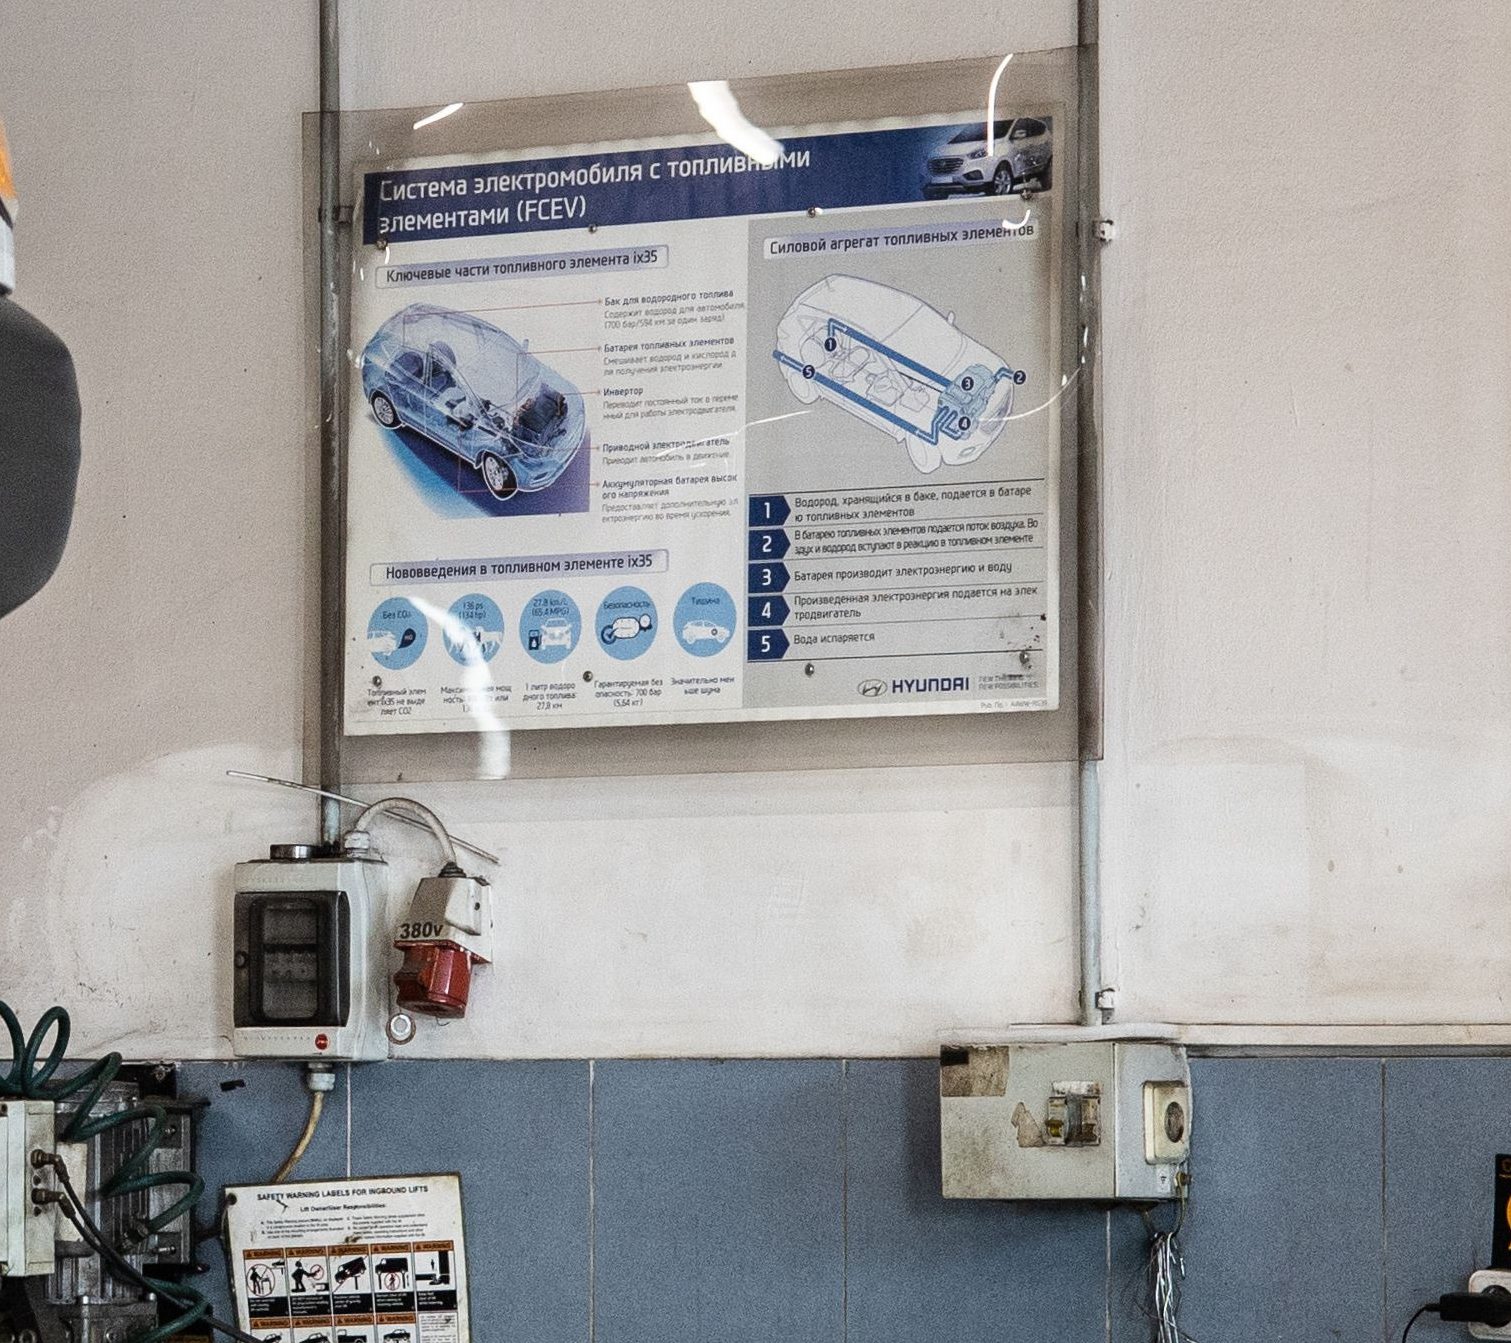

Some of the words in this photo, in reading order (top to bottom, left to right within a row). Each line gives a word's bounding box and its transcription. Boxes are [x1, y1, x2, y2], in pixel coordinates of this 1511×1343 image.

[380, 177, 466, 201] Система
[474, 162, 642, 194] электромобиля
[651, 162, 660, 180] с
[517, 196, 586, 226] (FCEV)
[771, 238, 826, 254] Силовой
[830, 236, 879, 252] агрегат
[884, 230, 957, 246] топливных
[962, 225, 1034, 240] элементов
[386, 266, 451, 283] Ключевые
[455, 264, 489, 278] части
[494, 258, 566, 275] топливного
[570, 253, 628, 270] элемента
[633, 248, 657, 265] ix35
[605, 296, 620, 306] Бак
[623, 296, 638, 306] для
[642, 293, 696, 304] водородного
[700, 290, 733, 299] топлива
[605, 343, 637, 354] Батарея
[641, 340, 686, 350] топливных
[689, 337, 734, 347] элементов
[604, 387, 643, 397] Инвертор
[603, 440, 649, 454] Приводной
[603, 478, 672, 489] Аккумуляторная
[676, 476, 708, 485] батарея
[712, 474, 737, 482] высок
[619, 489, 669, 498] напряжения
[842, 492, 902, 507] хранящийся
[905, 493, 910, 502] в
[942, 490, 986, 501] подается
[990, 489, 995, 498] в
[999, 487, 1031, 499] батаре
[764, 502, 771, 519] 1
[795, 514, 803, 522] ю
[806, 511, 859, 522] топливных
[863, 508, 914, 519] элементов
[795, 530, 800, 540] В
[802, 529, 835, 541] батарею
[838, 528, 881, 538] топливных
[883, 526, 925, 536] элементов
[928, 524, 964, 534] подается
[966, 522, 988, 532] поток
[1028, 518, 1038, 529] Во
[762, 537, 772, 552] 2
[795, 545, 813, 556] здух
[815, 545, 820, 553] и
[822, 543, 856, 554] водород
[858, 541, 894, 553] вступают
[897, 541, 902, 549] в
[904, 539, 938, 551] реакцию
[941, 539, 946, 547] в
[948, 537, 992, 547] топливном
[995, 535, 1033, 545] элементе
[386, 563, 476, 580] Нововведения
[480, 565, 488, 575] в
[491, 560, 561, 574] топливном
[564, 557, 624, 571] элементе
[627, 554, 653, 568] ix35
[795, 570, 833, 582] Батарея
[836, 569, 892, 581] производит
[896, 565, 975, 578] электроэнергию
[978, 565, 984, 573] и
[988, 564, 1012, 575] воду
[762, 570, 771, 585] 3
[795, 594, 869, 608] Произведенная
[872, 590, 949, 603] электроэнергия
[953, 588, 997, 599] подается
[1000, 587, 1012, 596] на
[1016, 586, 1037, 595] элек
[762, 603, 771, 618] 4
[795, 609, 861, 622] тродвигатель
[762, 637, 770, 651] 5
[794, 634, 818, 645] Вода
[821, 633, 874, 645] испаряется
[892, 677, 969, 694] HYUNDAI
[400, 921, 444, 940] 380v
[258, 1192, 284, 1201] SAFETY
[286, 1190, 319, 1199] WARNING
[322, 1188, 350, 1197] LABELS
[352, 1187, 366, 1196] FOR
[369, 1185, 406, 1195] INGROUND
[409, 1184, 428, 1193] LIFTS
